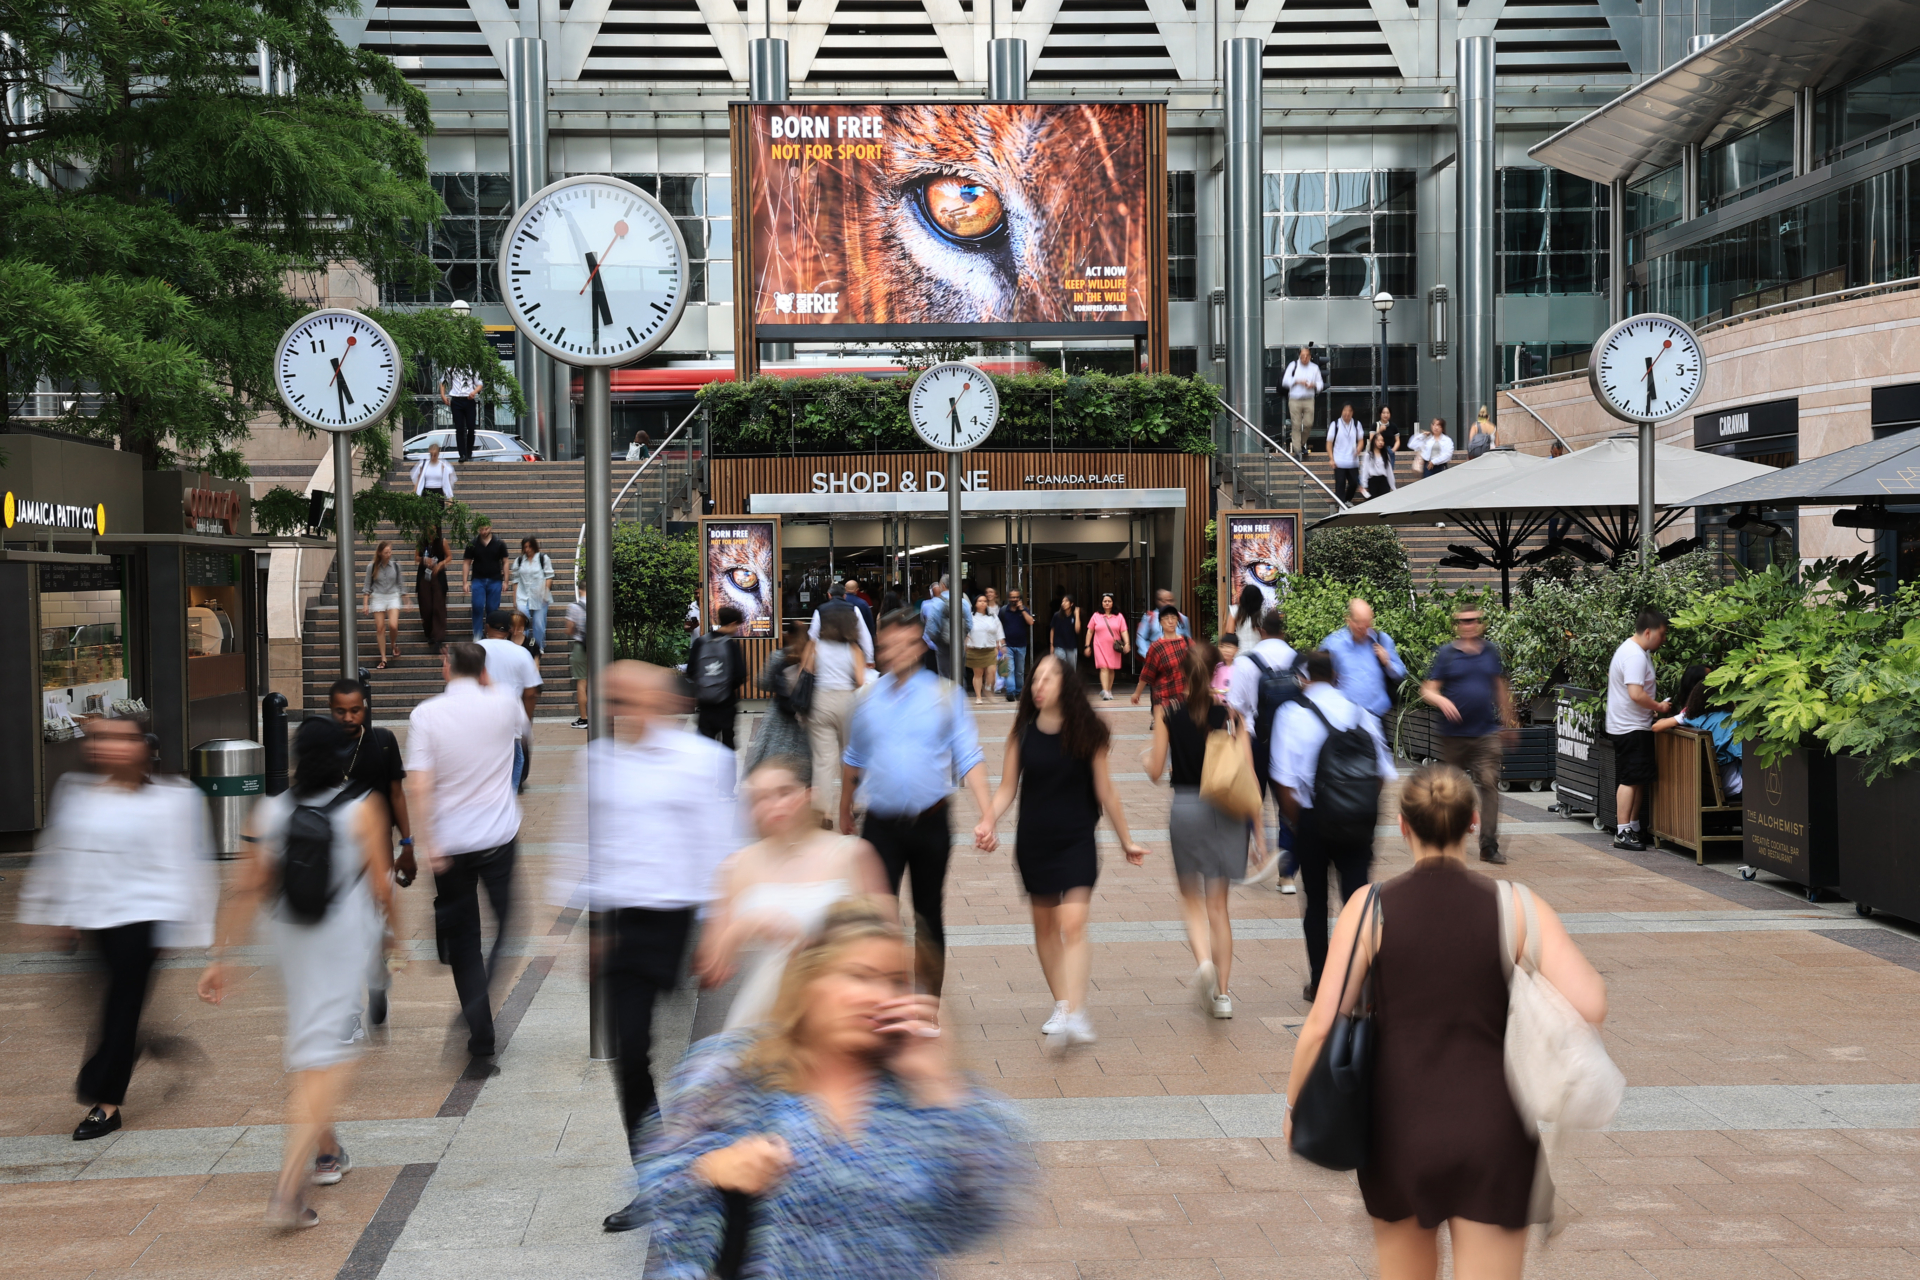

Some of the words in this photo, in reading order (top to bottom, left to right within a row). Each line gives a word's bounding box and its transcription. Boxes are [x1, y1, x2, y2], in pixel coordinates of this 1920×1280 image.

[771, 116, 830, 138] BORN
[838, 116, 882, 138] FREE
[771, 144, 800, 160] NOT
[805, 144, 833, 160] FOR
[838, 144, 882, 160] SPORT
[1086, 266, 1102, 276] ACT
[1104, 266, 1126, 276] NOW
[1065, 280, 1086, 290] KEEP
[1088, 279, 1126, 290] WILDLIFE
[807, 292, 839, 314] FREE
[1074, 292, 1084, 302] IN
[1086, 292, 1102, 302] THE
[1104, 292, 1126, 302] WILD
[310, 340, 325, 354] 11
[1676, 364, 1684, 376] 3
[970, 416, 978, 426] 4
[1719, 412, 1749, 436] CARAVAN
[812, 472, 890, 494] SHOP
[900, 471, 918, 492] &
[926, 470, 989, 492] DNE
[1036, 474, 1086, 484] CANADA
[1088, 474, 1125, 484] PLACE
[16, 499, 55, 526] JAMAICA
[57, 504, 80, 528] PATTY
[82, 507, 96, 530] CO.
[1747, 810, 1756, 819] THE
[1758, 813, 1804, 836] ALCHEMIST
[1752, 834, 1770, 848] CREATIVE
[1771, 840, 1790, 854] COCKTAIL
[1790, 846, 1799, 856] BAR
[1768, 849, 1792, 864] RESTAURANT
